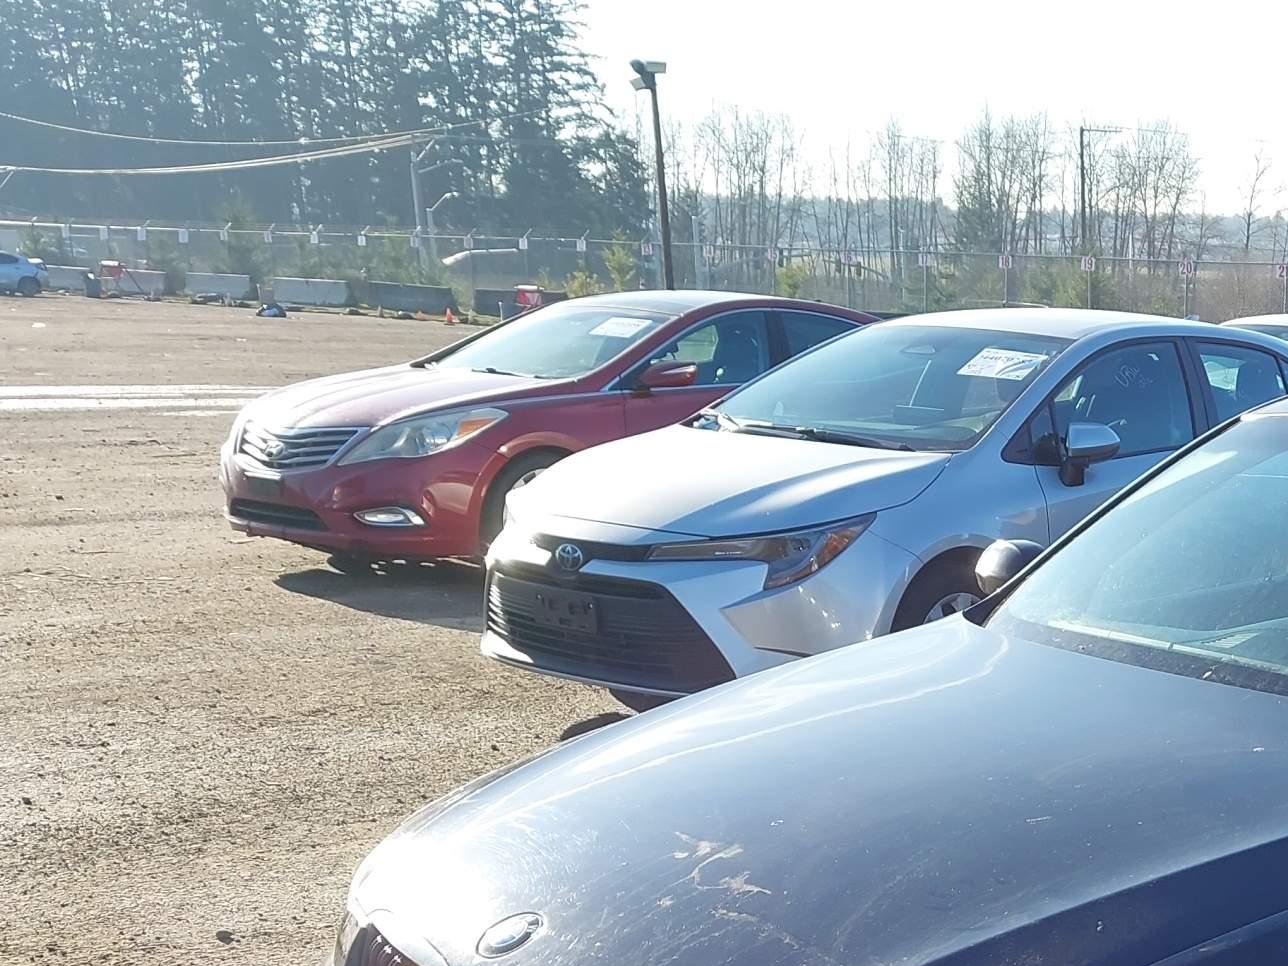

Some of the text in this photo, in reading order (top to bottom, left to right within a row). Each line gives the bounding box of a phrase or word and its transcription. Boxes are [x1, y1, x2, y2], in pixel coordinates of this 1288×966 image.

[1083, 258, 1093, 270] 19
[1180, 262, 1192, 274] 20
[1279, 265, 1288, 278] 21
